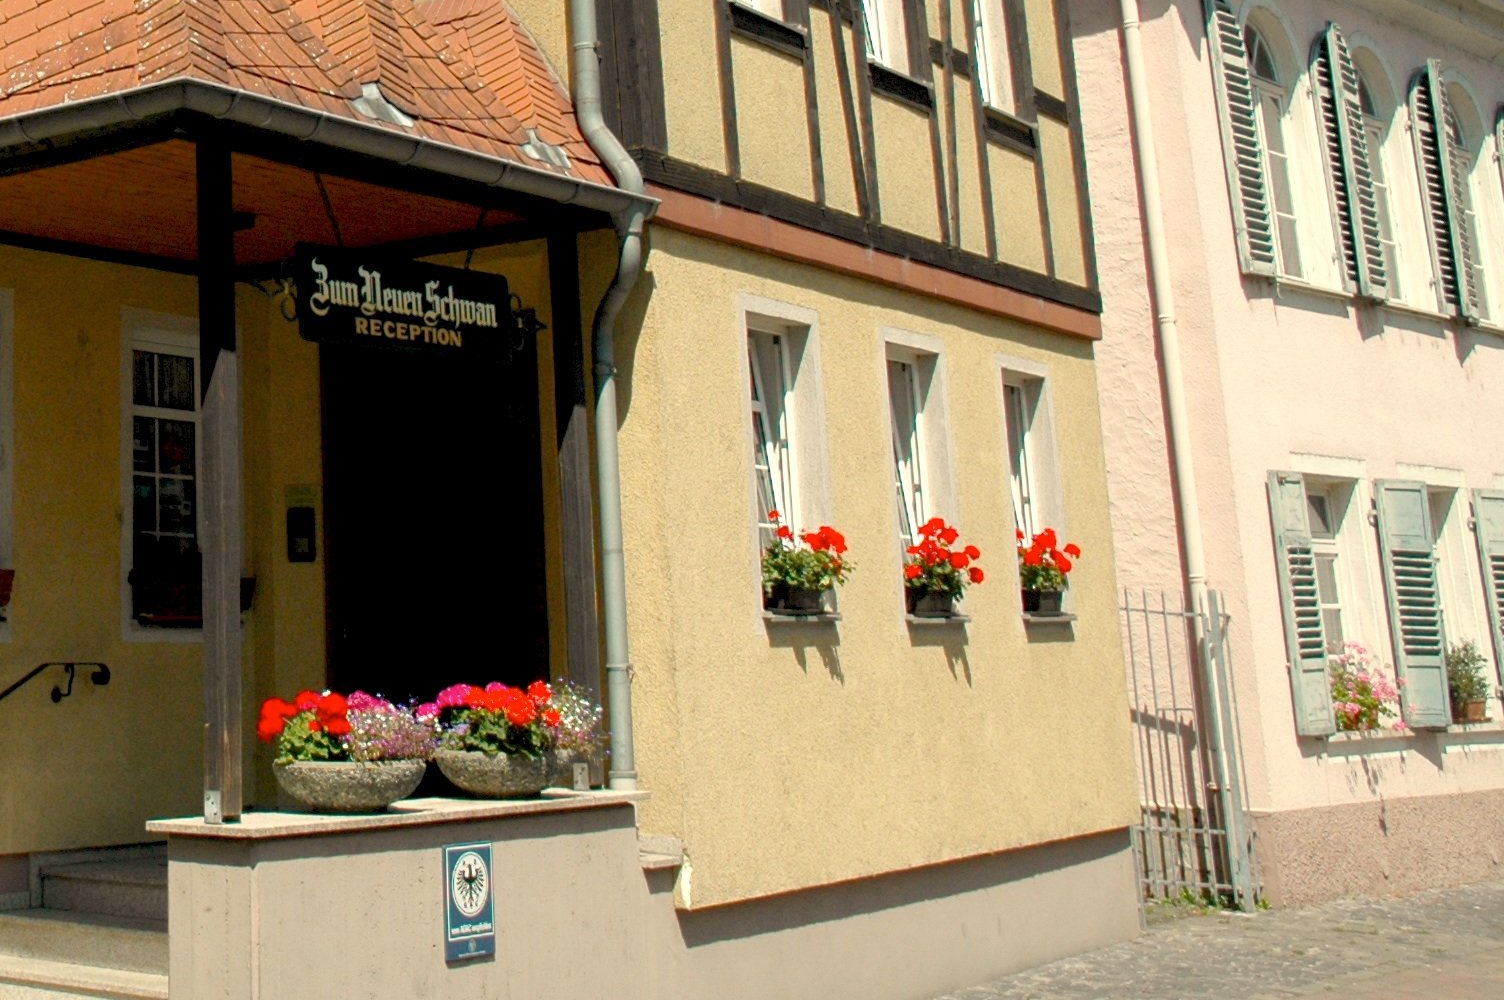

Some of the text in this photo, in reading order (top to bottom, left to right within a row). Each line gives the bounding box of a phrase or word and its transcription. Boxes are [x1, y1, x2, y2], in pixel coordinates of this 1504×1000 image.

[310, 257, 498, 329] Zum Neuen Schwan
[355, 317, 463, 347] RECEPTION
